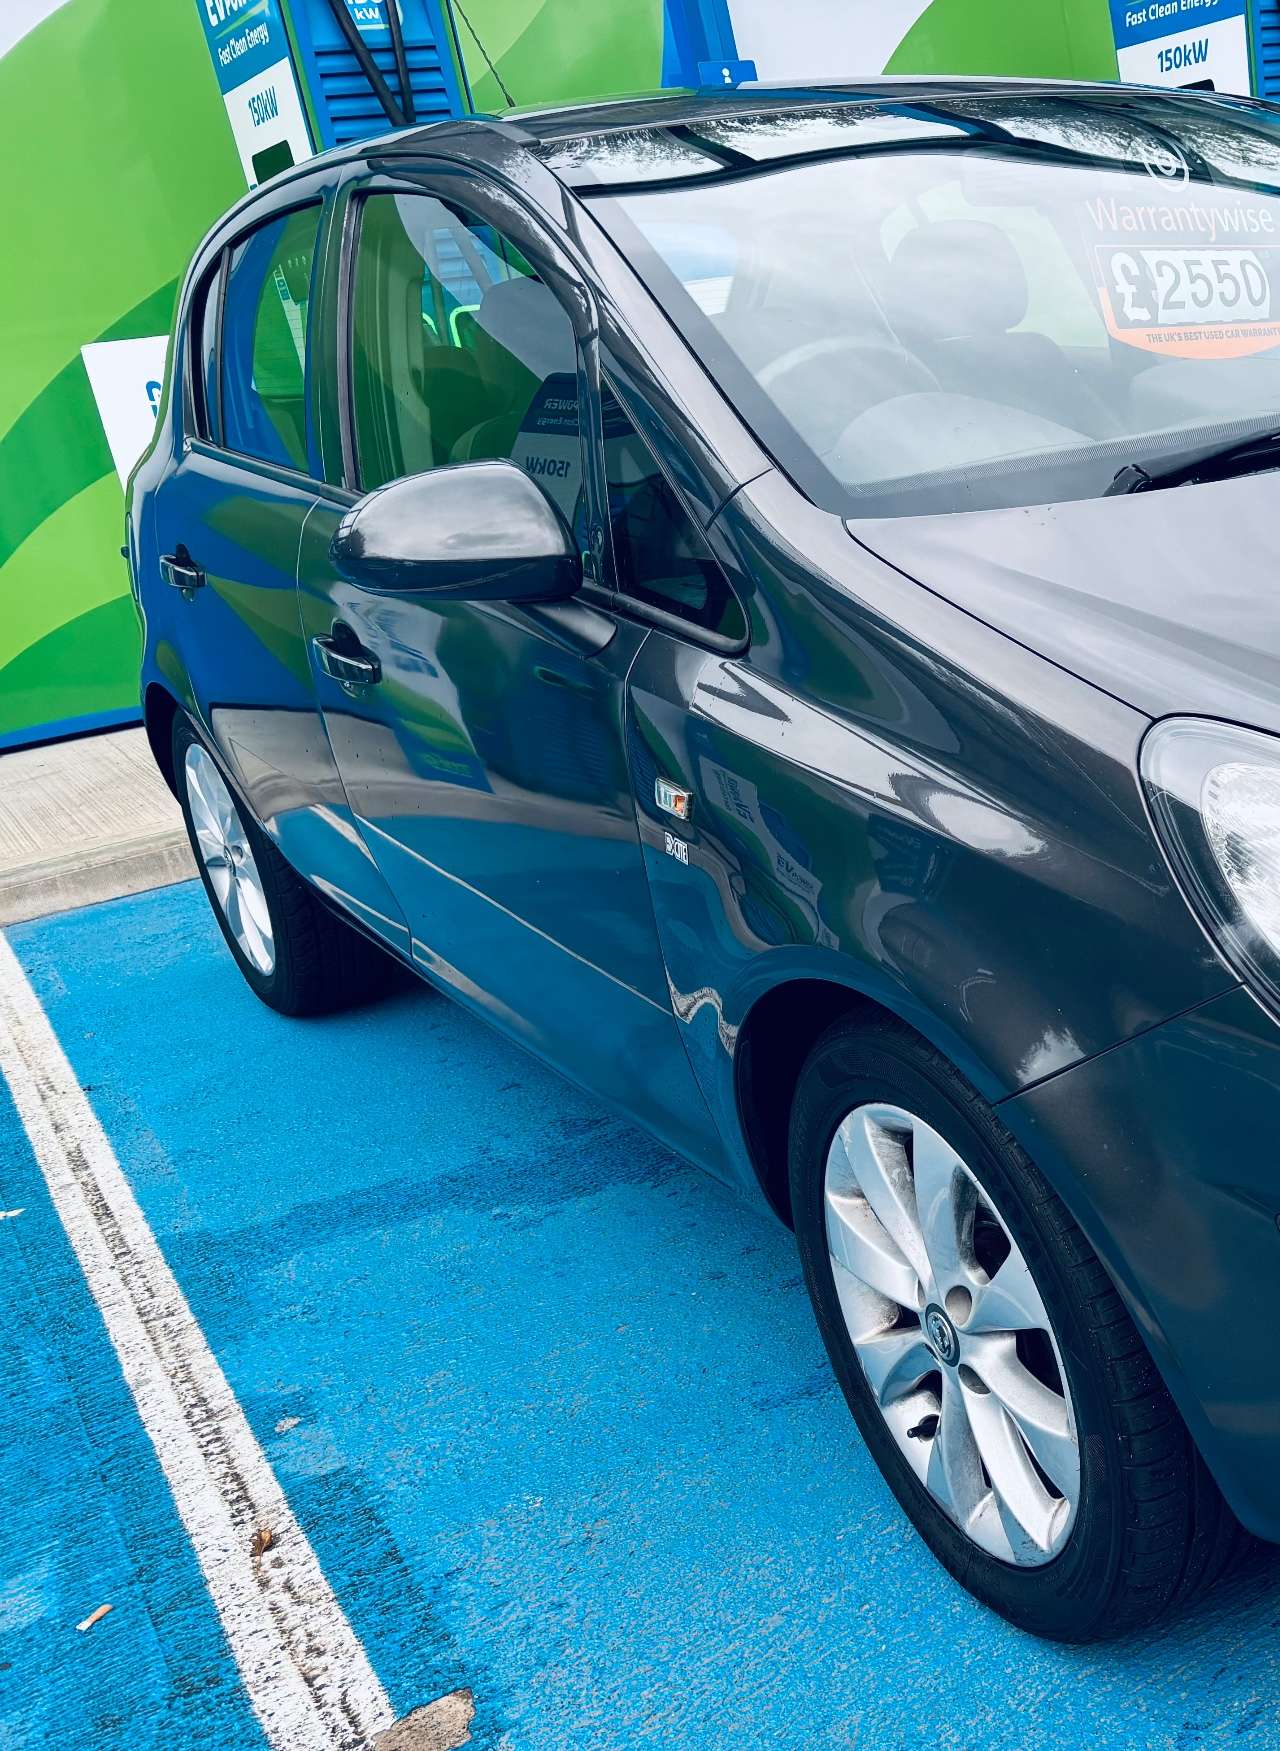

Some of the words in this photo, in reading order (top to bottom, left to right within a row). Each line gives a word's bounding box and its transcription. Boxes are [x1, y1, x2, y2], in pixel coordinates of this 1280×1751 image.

[353, 7, 381, 20] kW
[1125, 9, 1147, 28] Fast
[1148, 1, 1178, 20] Clean
[217, 47, 233, 68] Fast
[244, 21, 269, 46] Energy
[1157, 38, 1209, 73] 150kW
[248, 86, 280, 128] 150kW
[1086, 196, 1275, 242] Warrantywise
[1146, 333, 1163, 344] THE
[1184, 331, 1203, 341] BEST
[1203, 330, 1224, 341] USED
[1225, 329, 1241, 339] CAR
[1241, 327, 1280, 338] WARRANTY
